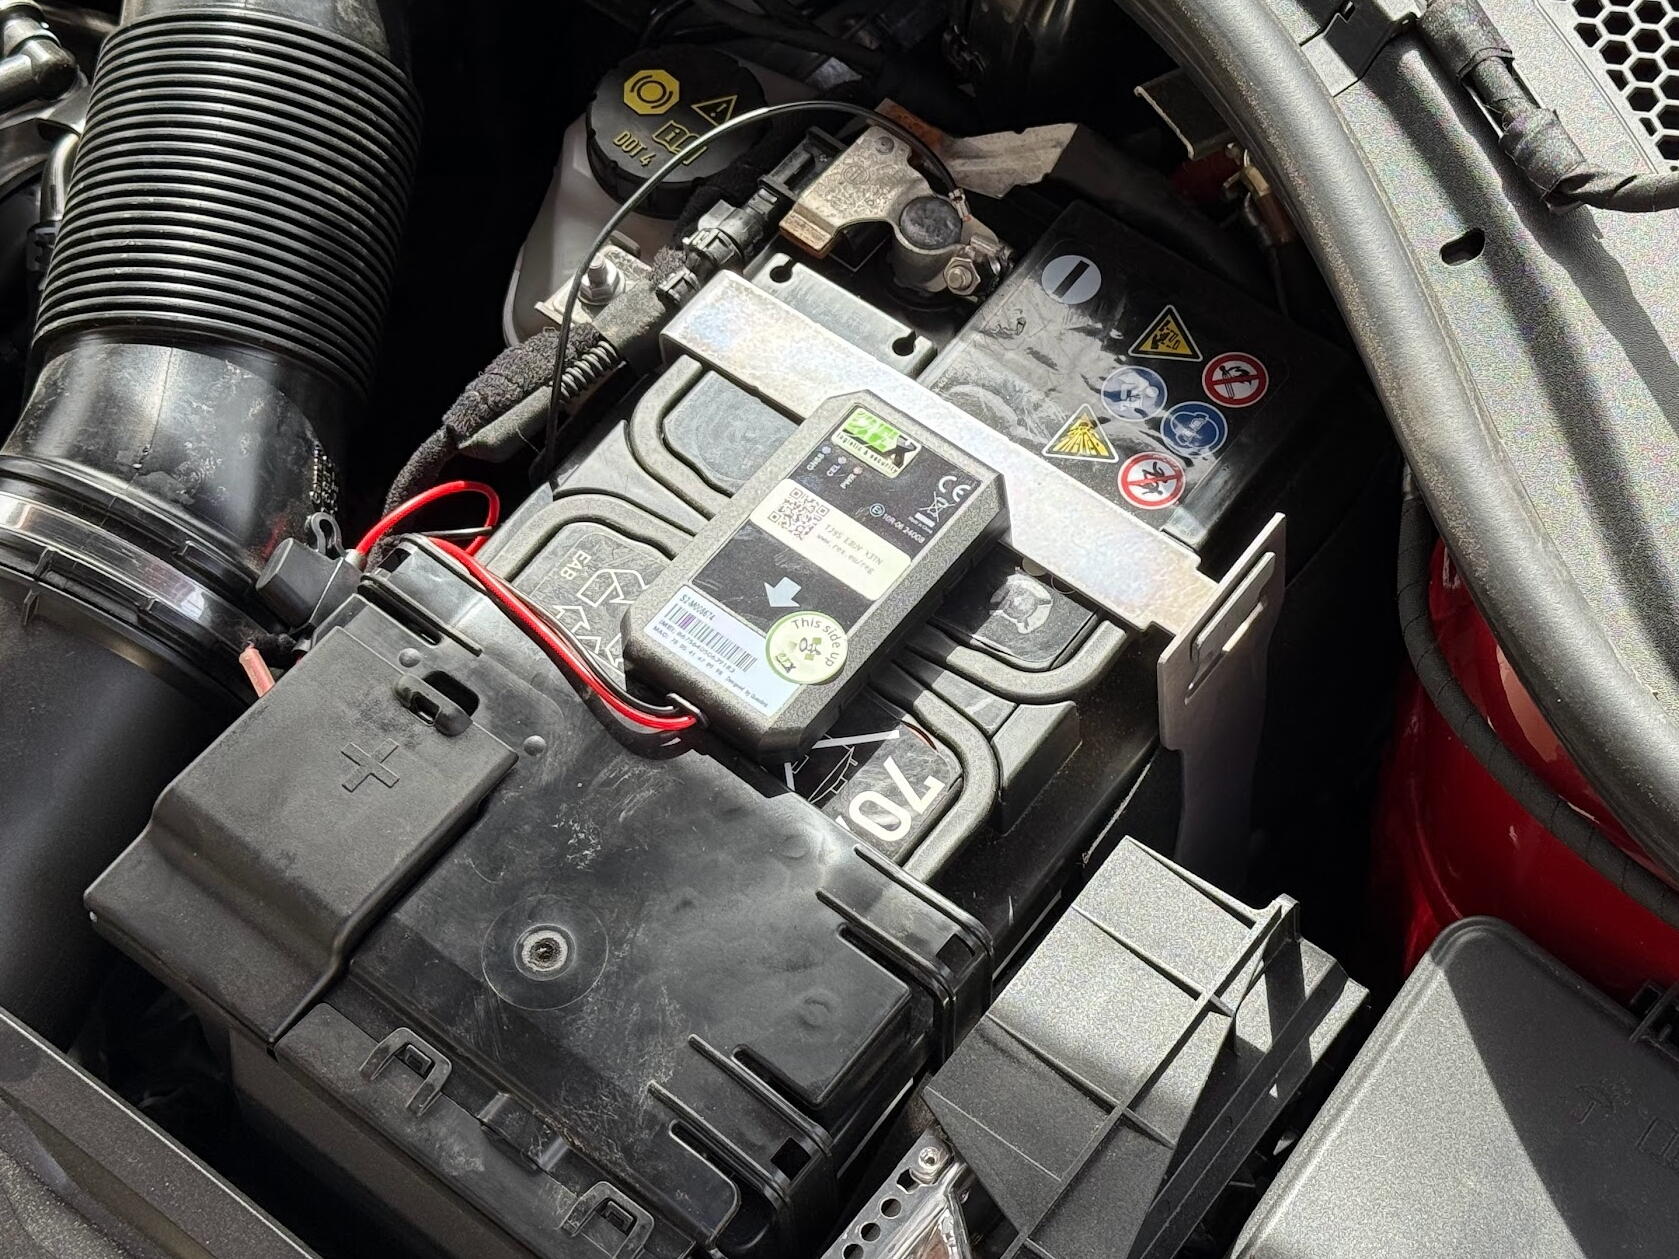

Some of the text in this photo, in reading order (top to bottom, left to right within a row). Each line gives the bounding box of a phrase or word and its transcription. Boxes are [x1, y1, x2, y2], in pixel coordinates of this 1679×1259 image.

[613, 131, 656, 167] DOT 4
[560, 550, 592, 580] EAB
[791, 617, 842, 667] This side up
[849, 756, 946, 842] 70
